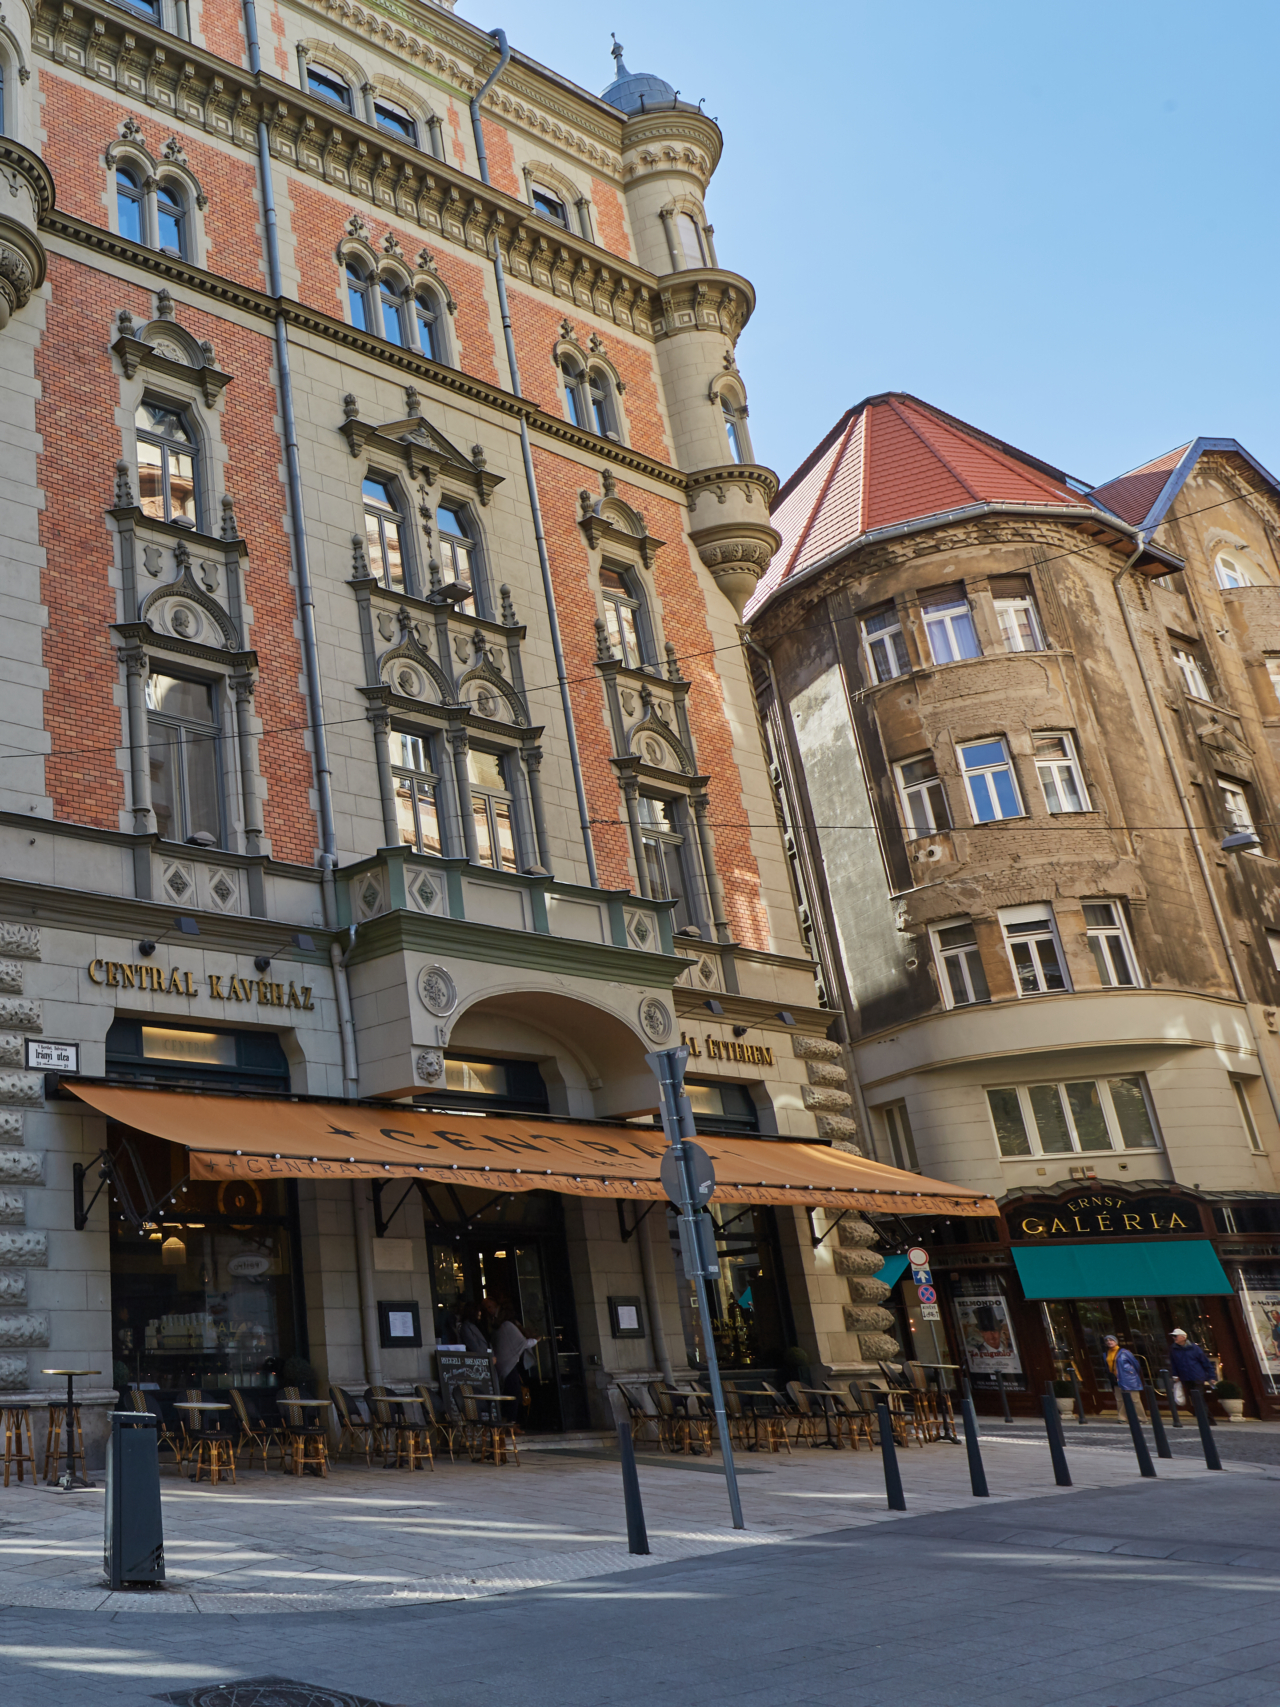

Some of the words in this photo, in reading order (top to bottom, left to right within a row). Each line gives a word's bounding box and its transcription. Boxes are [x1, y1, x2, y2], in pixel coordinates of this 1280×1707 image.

[88, 958, 199, 997] CENTRÁL
[208, 973, 315, 1010] KÁVÉHÁZ
[35, 1049, 53, 1063] Irányi
[57, 1052, 70, 1061] utca
[705, 1034, 775, 1066] ÉTTEREM
[246, 1159, 370, 1174] CENTRAL
[567, 1176, 658, 1196] CENTRAL
[809, 1191, 883, 1210] CENTRAL
[914, 1198, 983, 1214] CENTRAL
[1067, 1196, 1126, 1212] ERNST
[1021, 1211, 1188, 1234] GALÉRIA
[958, 1299, 1002, 1307] BELMONDO
